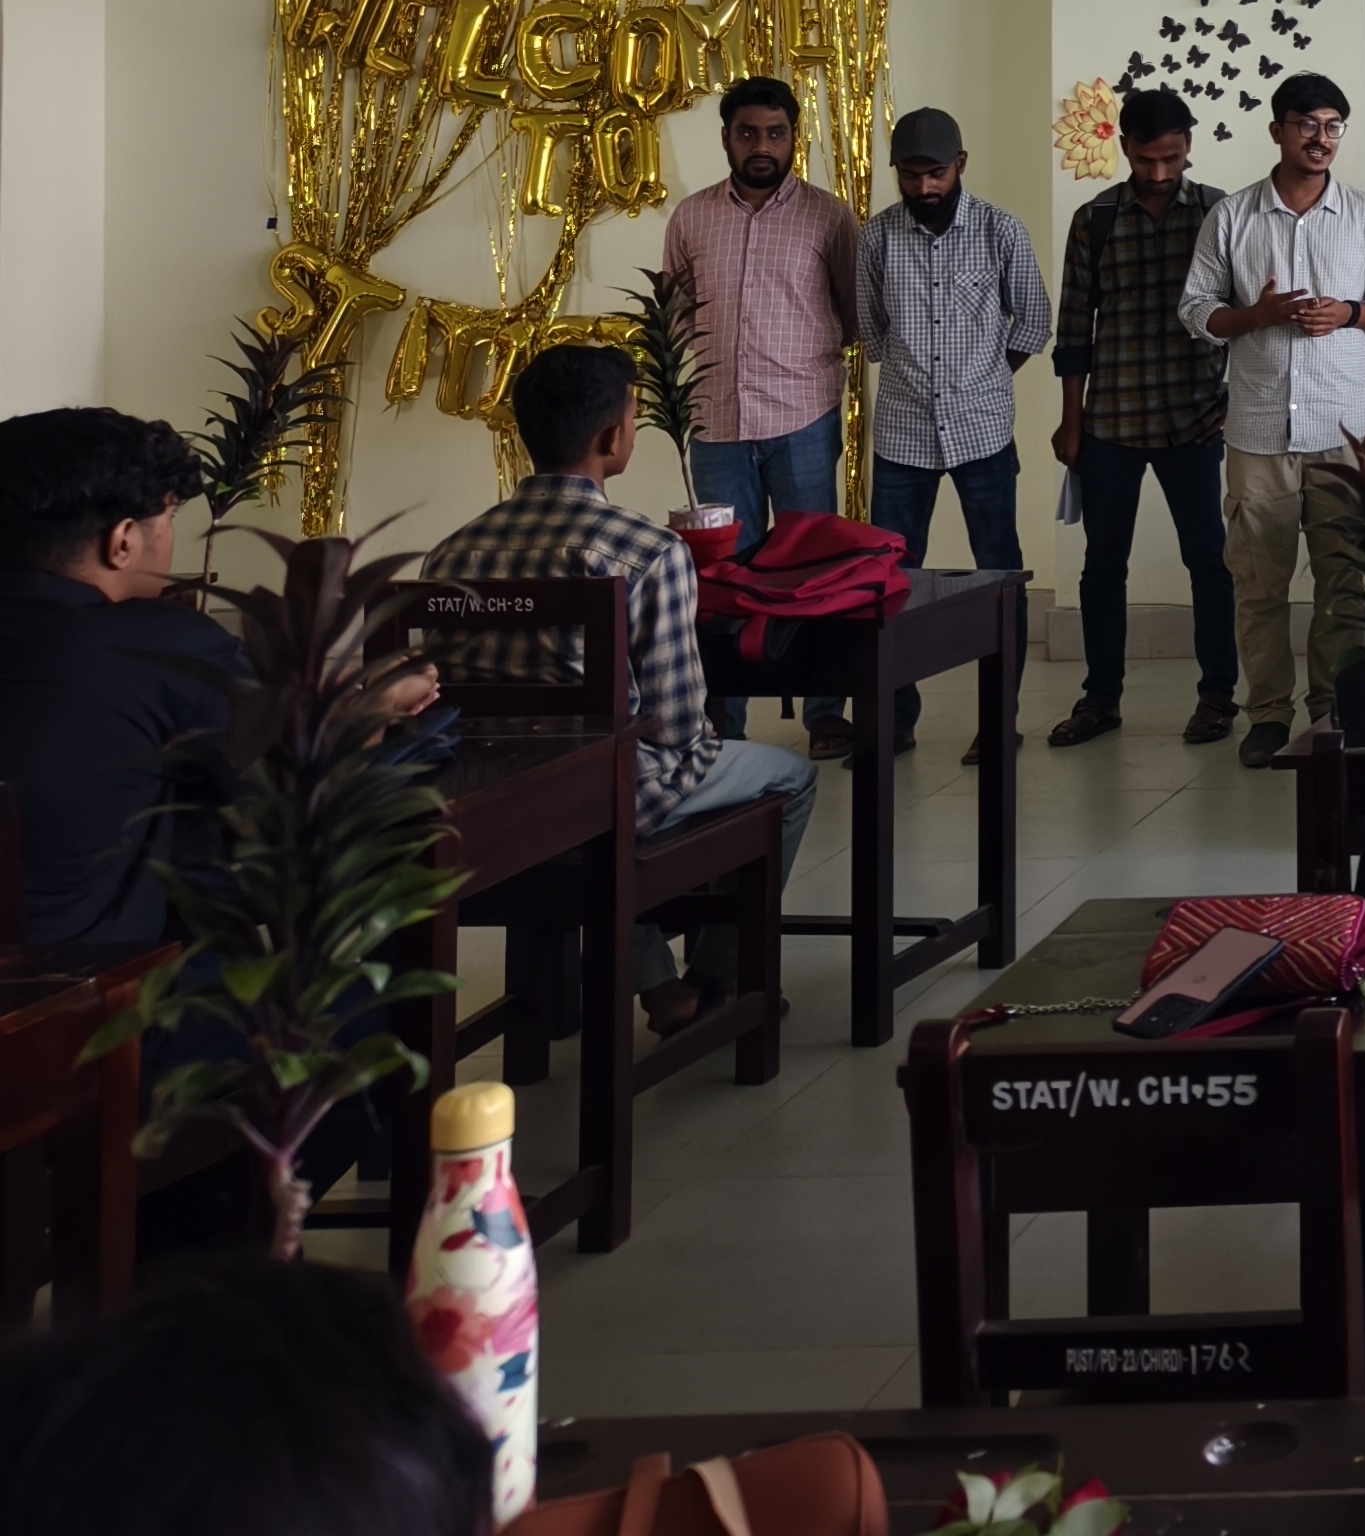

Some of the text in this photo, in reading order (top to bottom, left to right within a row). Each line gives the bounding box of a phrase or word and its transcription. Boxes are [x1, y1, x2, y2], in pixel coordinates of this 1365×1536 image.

[511, 107, 668, 219] TO
[487, 597, 535, 612] CH-29
[992, 1070, 1258, 1119] STAT/W. CH-55
